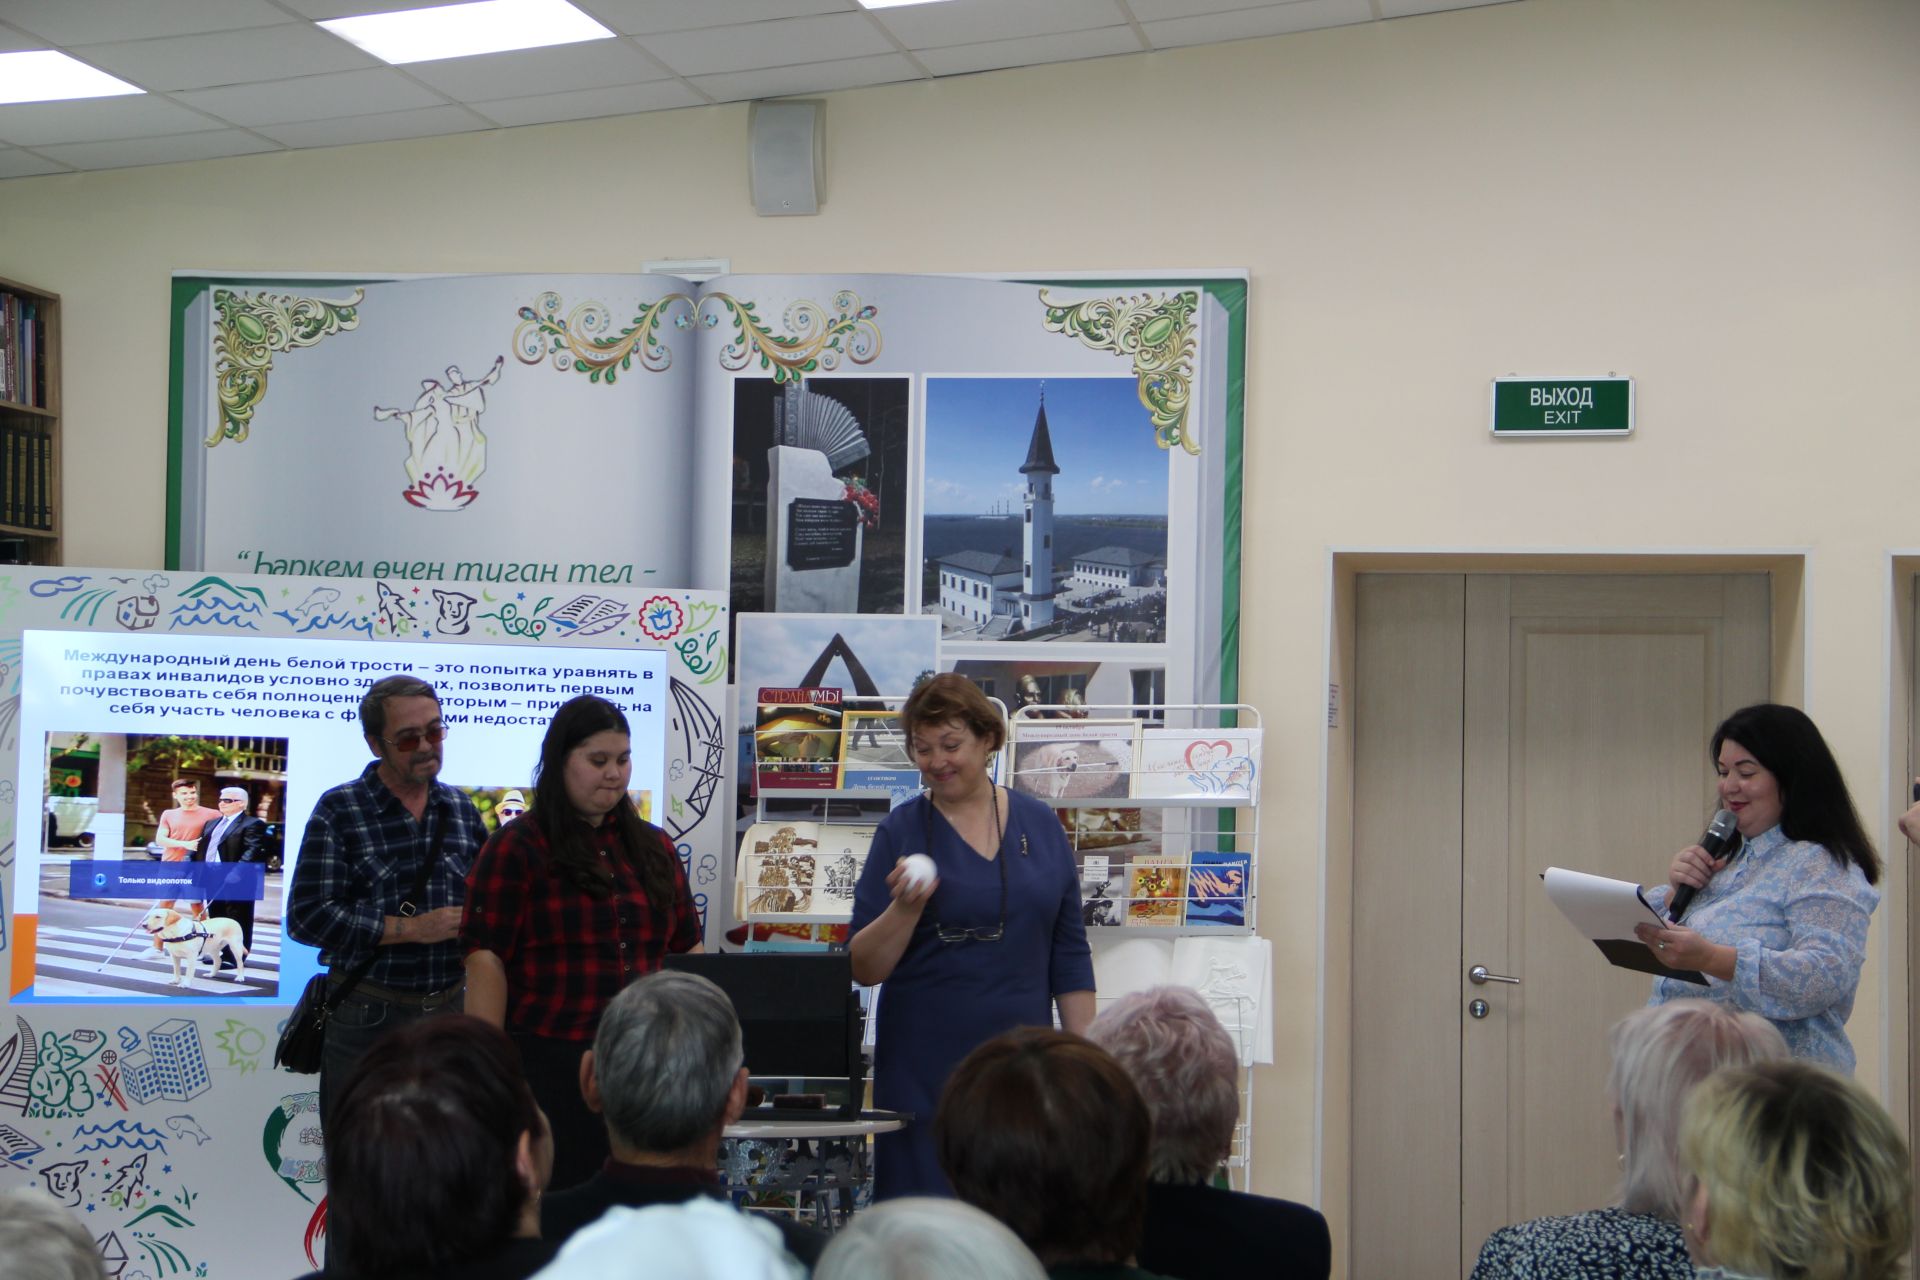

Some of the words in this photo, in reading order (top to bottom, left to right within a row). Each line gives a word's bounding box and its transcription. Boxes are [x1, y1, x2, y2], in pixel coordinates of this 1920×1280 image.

[1530, 387, 1593, 408] ВЫХОД
[1544, 410, 1582, 424] EXIT
[567, 563, 633, 583] тел
[64, 649, 231, 667] Международный
[234, 656, 280, 669] день
[287, 656, 346, 670] белой
[350, 661, 413, 675] трости
[435, 663, 464, 674] это
[469, 664, 547, 676] попытка
[552, 666, 638, 680] уравнять
[643, 670, 654, 680] в
[82, 668, 151, 682] правах
[156, 671, 265, 685] инвалидов
[269, 674, 350, 688] условно
[459, 680, 556, 693] позволить
[561, 684, 635, 696] первым
[60, 685, 208, 700] почувствовать
[212, 688, 257, 701] себя
[632, 702, 652, 712] на
[109, 702, 155, 715] себя
[160, 704, 225, 718] участь
[231, 706, 320, 720] человека
[325, 710, 335, 720] с
[118, 876, 146, 884] Только
[147, 876, 193, 885] видеопоток
